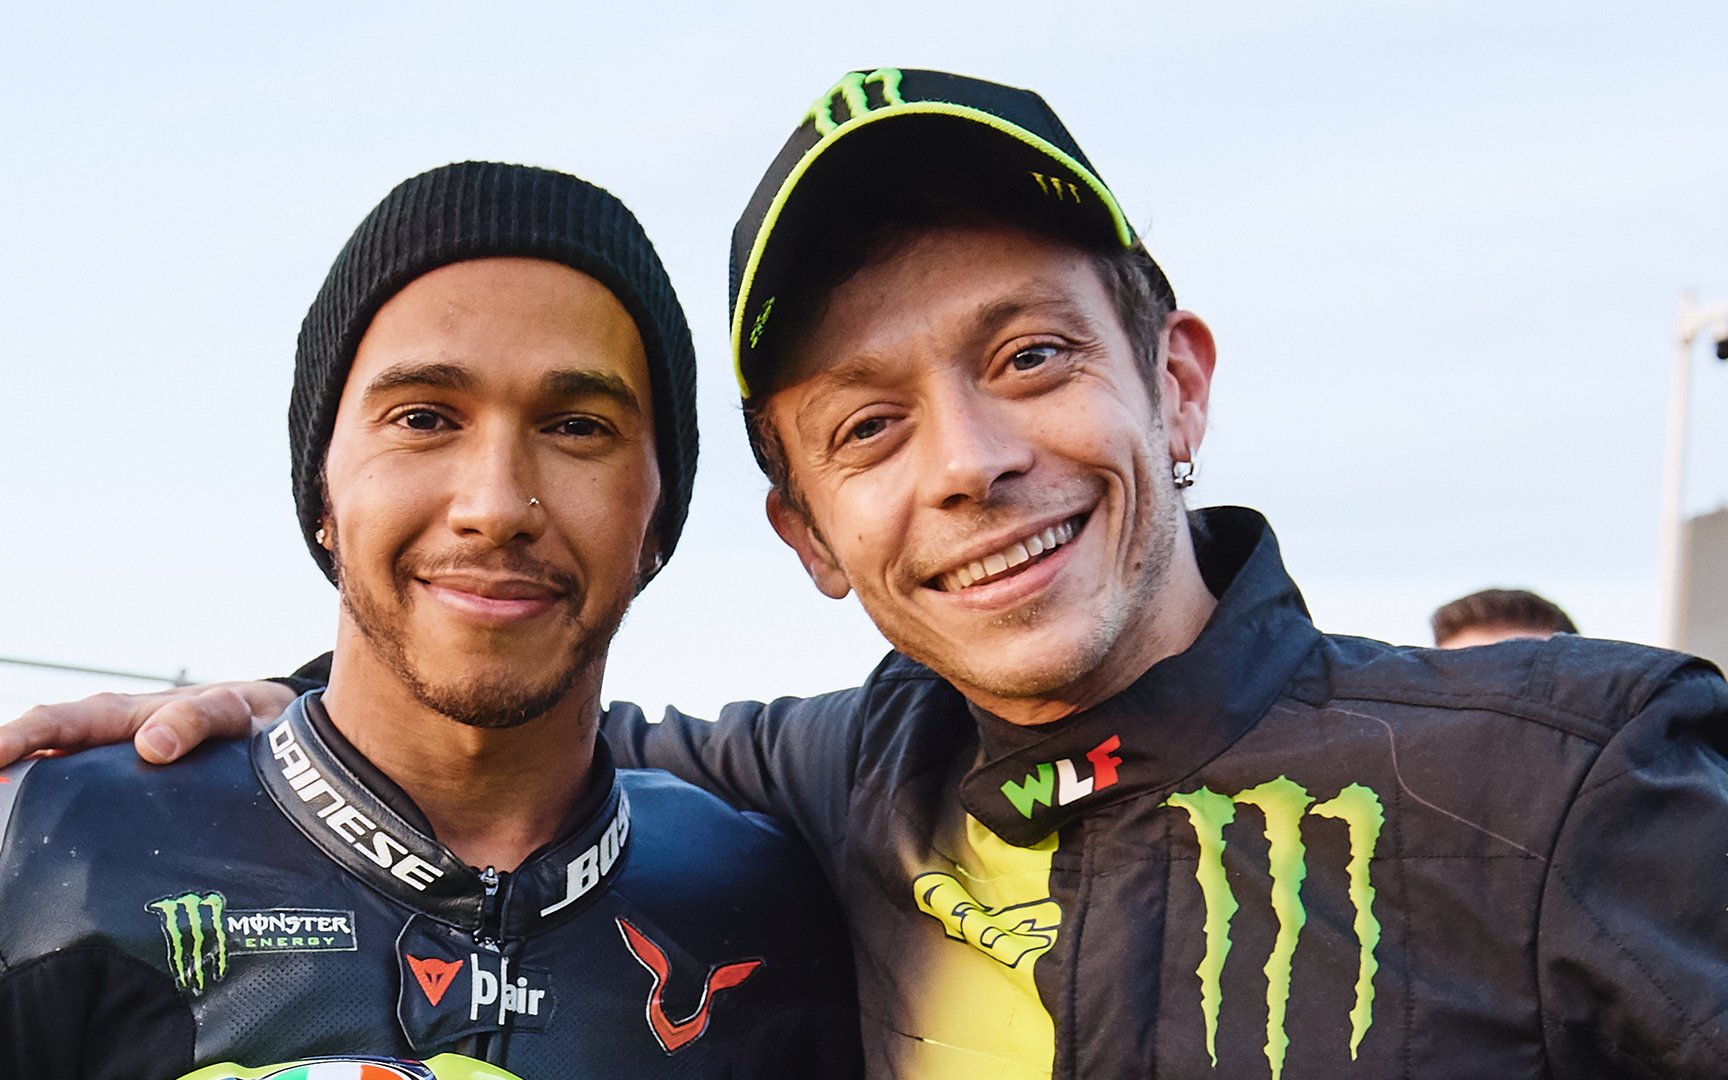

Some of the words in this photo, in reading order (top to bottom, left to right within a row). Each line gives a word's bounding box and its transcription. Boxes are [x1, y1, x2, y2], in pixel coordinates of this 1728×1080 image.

[1000, 735, 1122, 819] WLF
[268, 719, 445, 892] DAINESE
[227, 912, 352, 936] MONSTER
[245, 936, 335, 948] ENERGY
